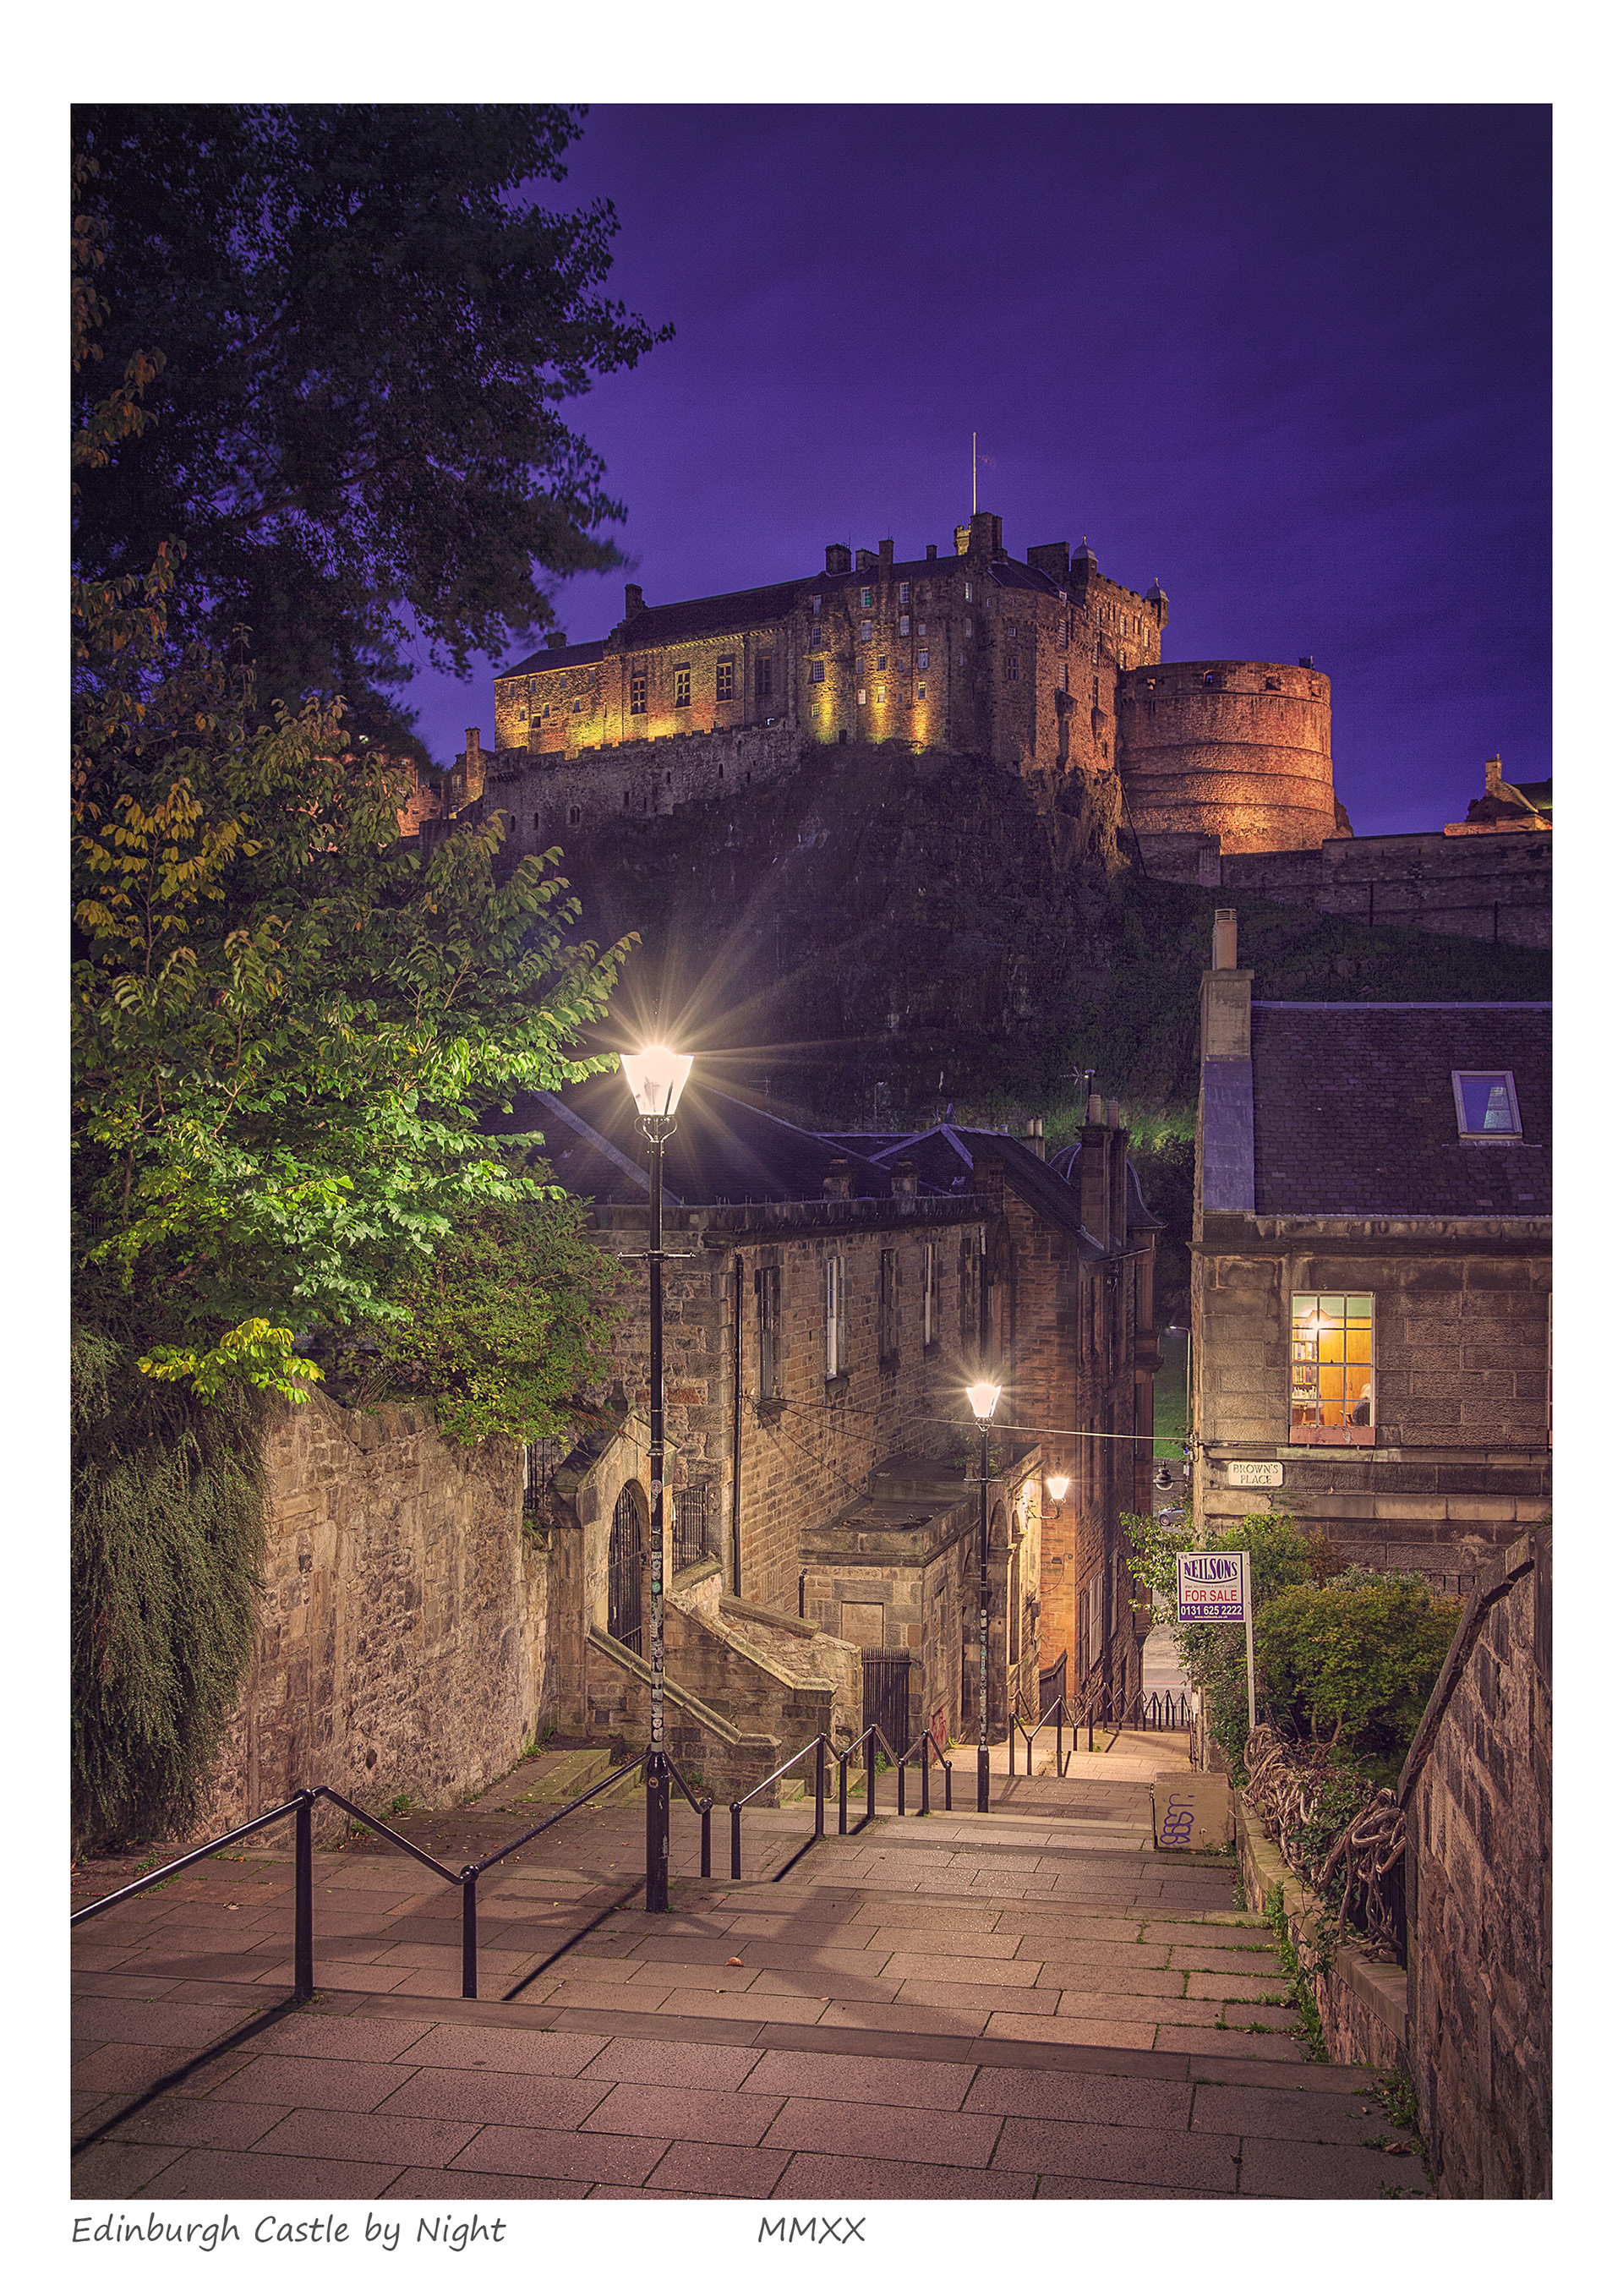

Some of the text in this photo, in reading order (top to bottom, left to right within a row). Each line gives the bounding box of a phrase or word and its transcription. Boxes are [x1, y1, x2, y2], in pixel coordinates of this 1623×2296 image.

[1232, 1464, 1279, 1473] BROWN'S
[1240, 1475, 1272, 1484] PLACE
[1183, 1558, 1238, 1580] NEILSONS
[1185, 1590, 1237, 1601] FOR SALE
[1181, 1605, 1242, 1615] 0131 625 2222
